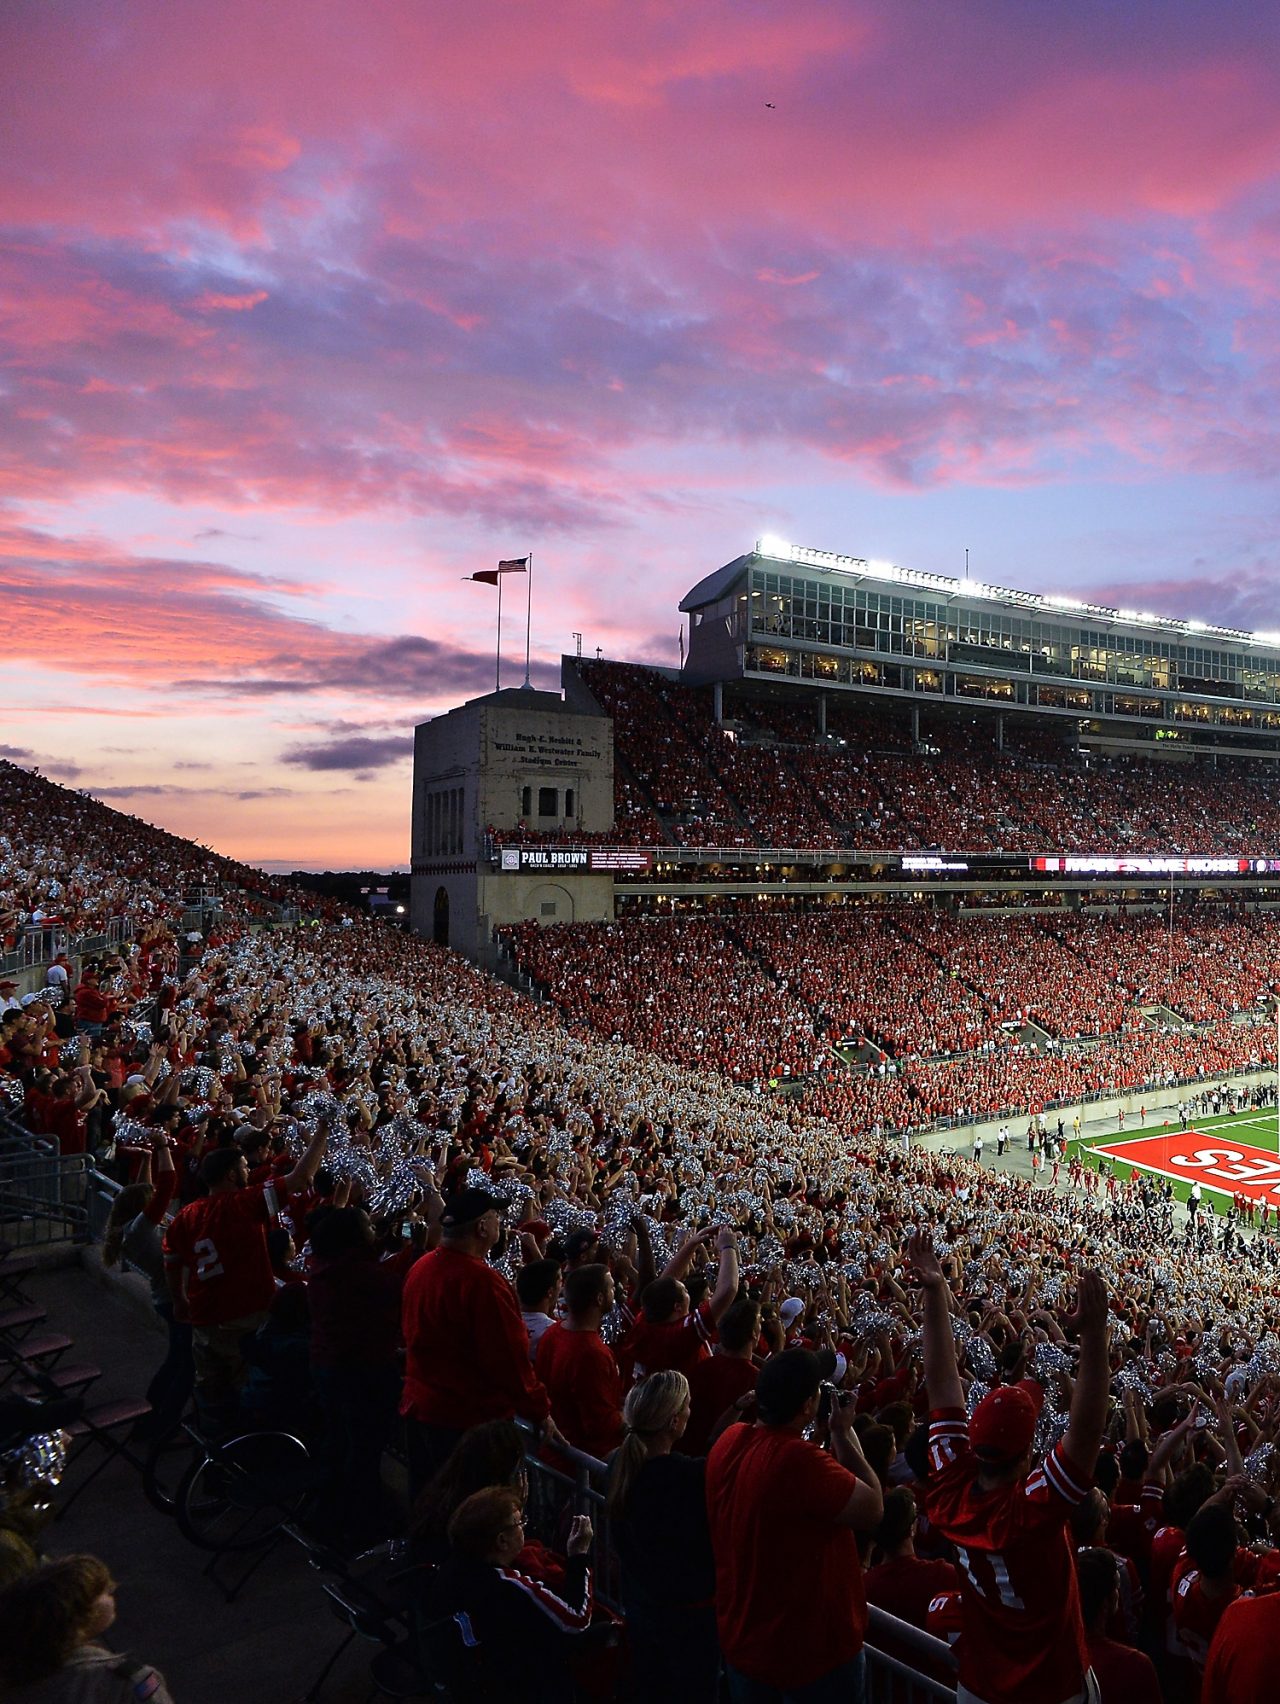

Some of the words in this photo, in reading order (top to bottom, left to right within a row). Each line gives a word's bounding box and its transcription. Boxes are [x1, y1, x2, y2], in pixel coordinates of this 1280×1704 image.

[516, 733, 536, 743] Hugh
[549, 736, 574, 745] Nesbitt
[577, 738, 582, 746] &
[495, 742, 526, 752] William
[538, 746, 574, 756] Westwater
[577, 749, 601, 759] Family
[521, 756, 552, 765] Stadium
[555, 758, 578, 767] Center
[521, 852, 549, 864] PAUL
[551, 852, 587, 864] BROWN
[192, 1237, 224, 1282] 2
[930, 1437, 958, 1471] 11
[955, 1545, 1027, 1612] 11
